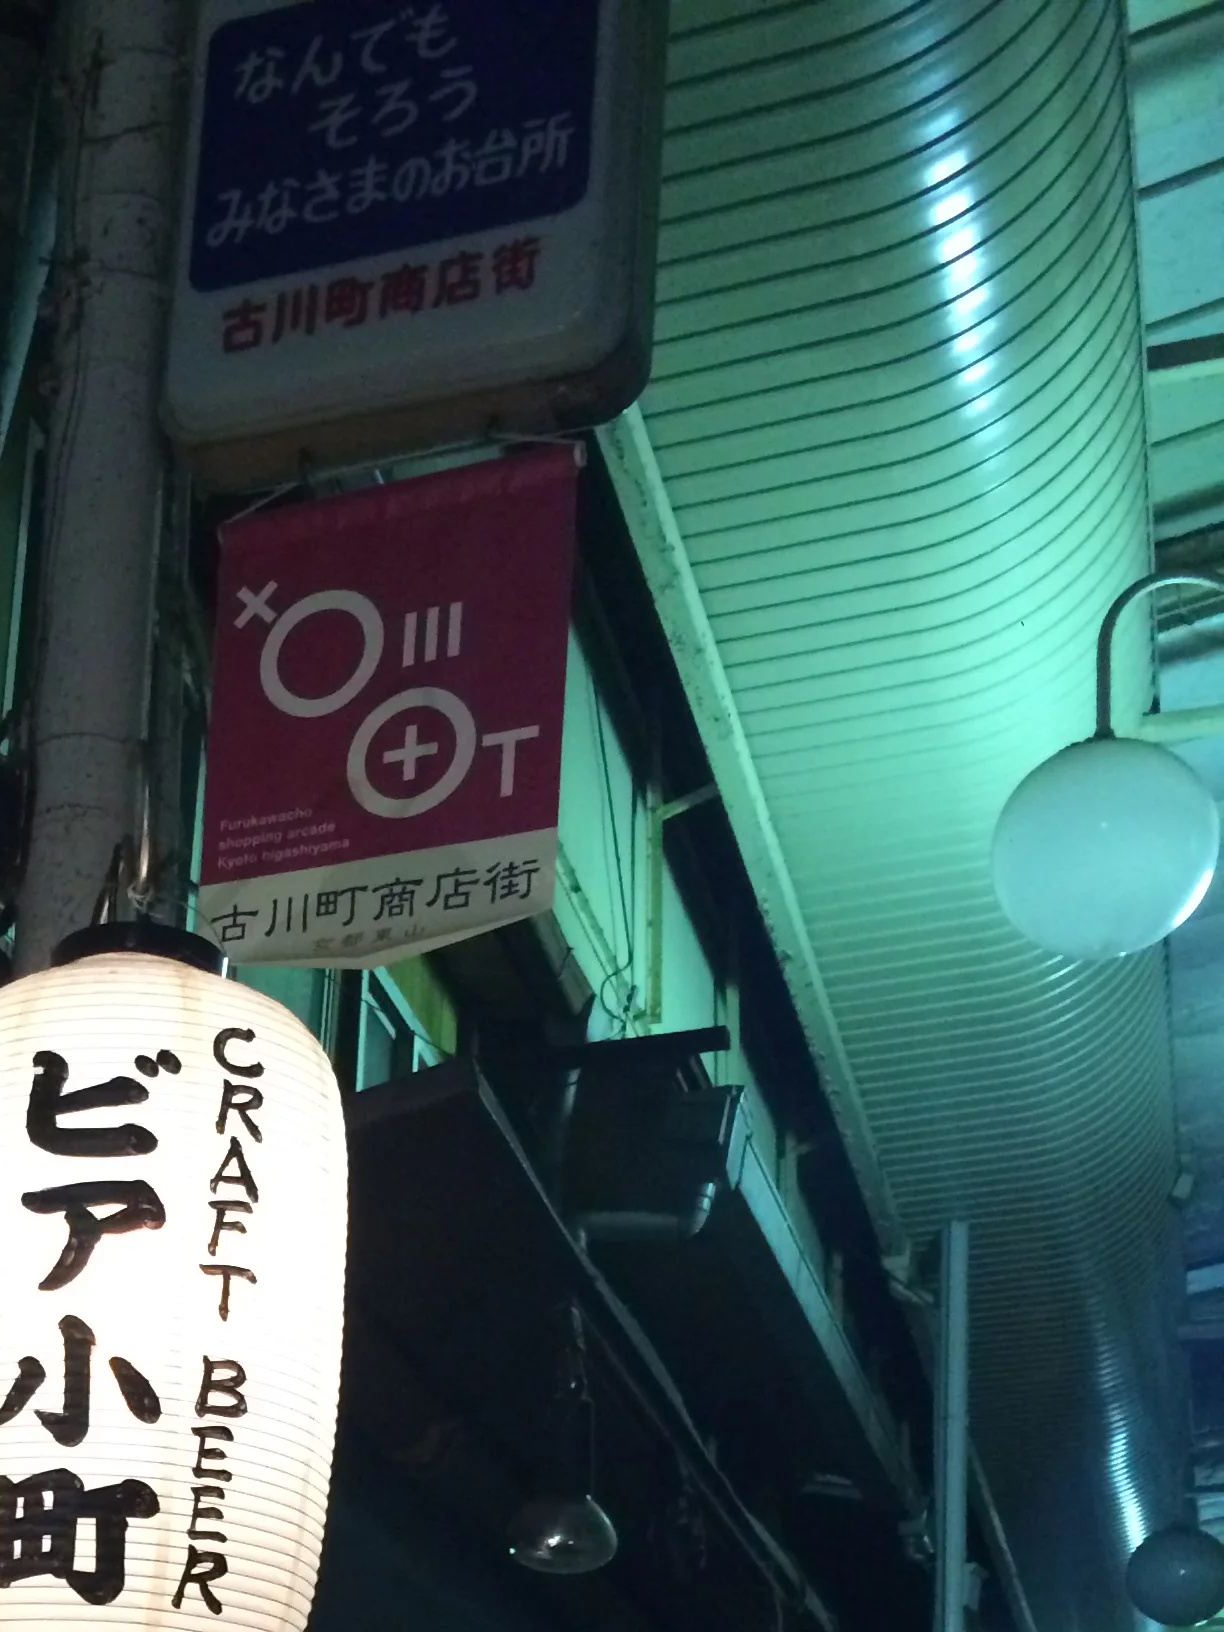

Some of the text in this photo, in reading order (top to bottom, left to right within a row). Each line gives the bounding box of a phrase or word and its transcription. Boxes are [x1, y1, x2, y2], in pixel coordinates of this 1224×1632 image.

[233, 3, 458, 103] なんでも
[308, 65, 477, 150] そろう
[206, 112, 575, 247] みなさまのお台所
[222, 236, 541, 353] 古川町商店街
[217, 838, 350, 870] Kyoto higashiyama
[218, 821, 336, 851] shopping arcade
[220, 807, 314, 833] Furukawacho
[211, 859, 541, 942] 古川町商店街
[171, 1027, 265, 1615] CRAFT BEER
